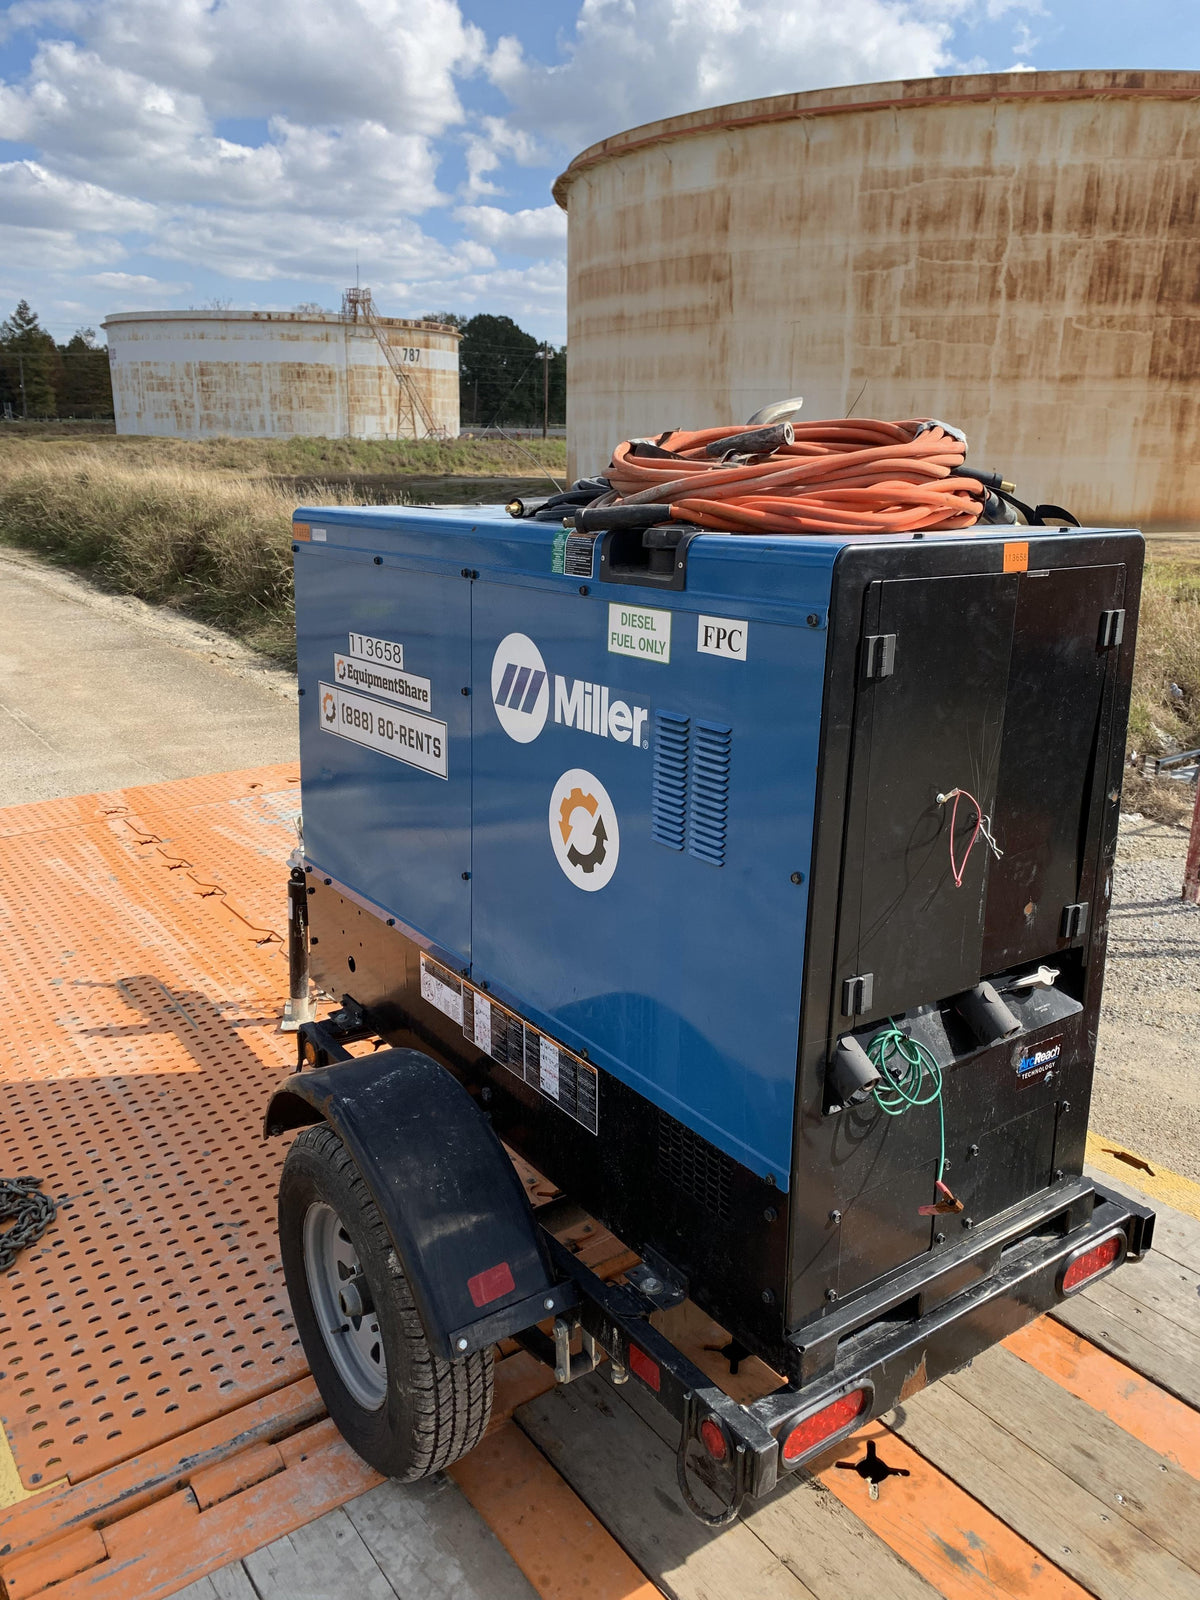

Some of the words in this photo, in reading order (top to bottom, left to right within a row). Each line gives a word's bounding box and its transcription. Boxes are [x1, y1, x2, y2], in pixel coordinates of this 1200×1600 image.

[402, 347, 420, 362] 787
[620, 611, 656, 632] DIESEL
[350, 634, 401, 664] 113658
[610, 632, 636, 650] FUEL
[638, 637, 666, 655] ONLY
[702, 625, 742, 653] FPC
[346, 664, 428, 702] EquipmentShare
[554, 674, 648, 748] Miller
[341, 702, 374, 734] (888)
[377, 718, 441, 758] 80-RENTS
[1018, 1044, 1061, 1071] ArcReach
[1021, 1061, 1056, 1079] TECHNOLOGY
